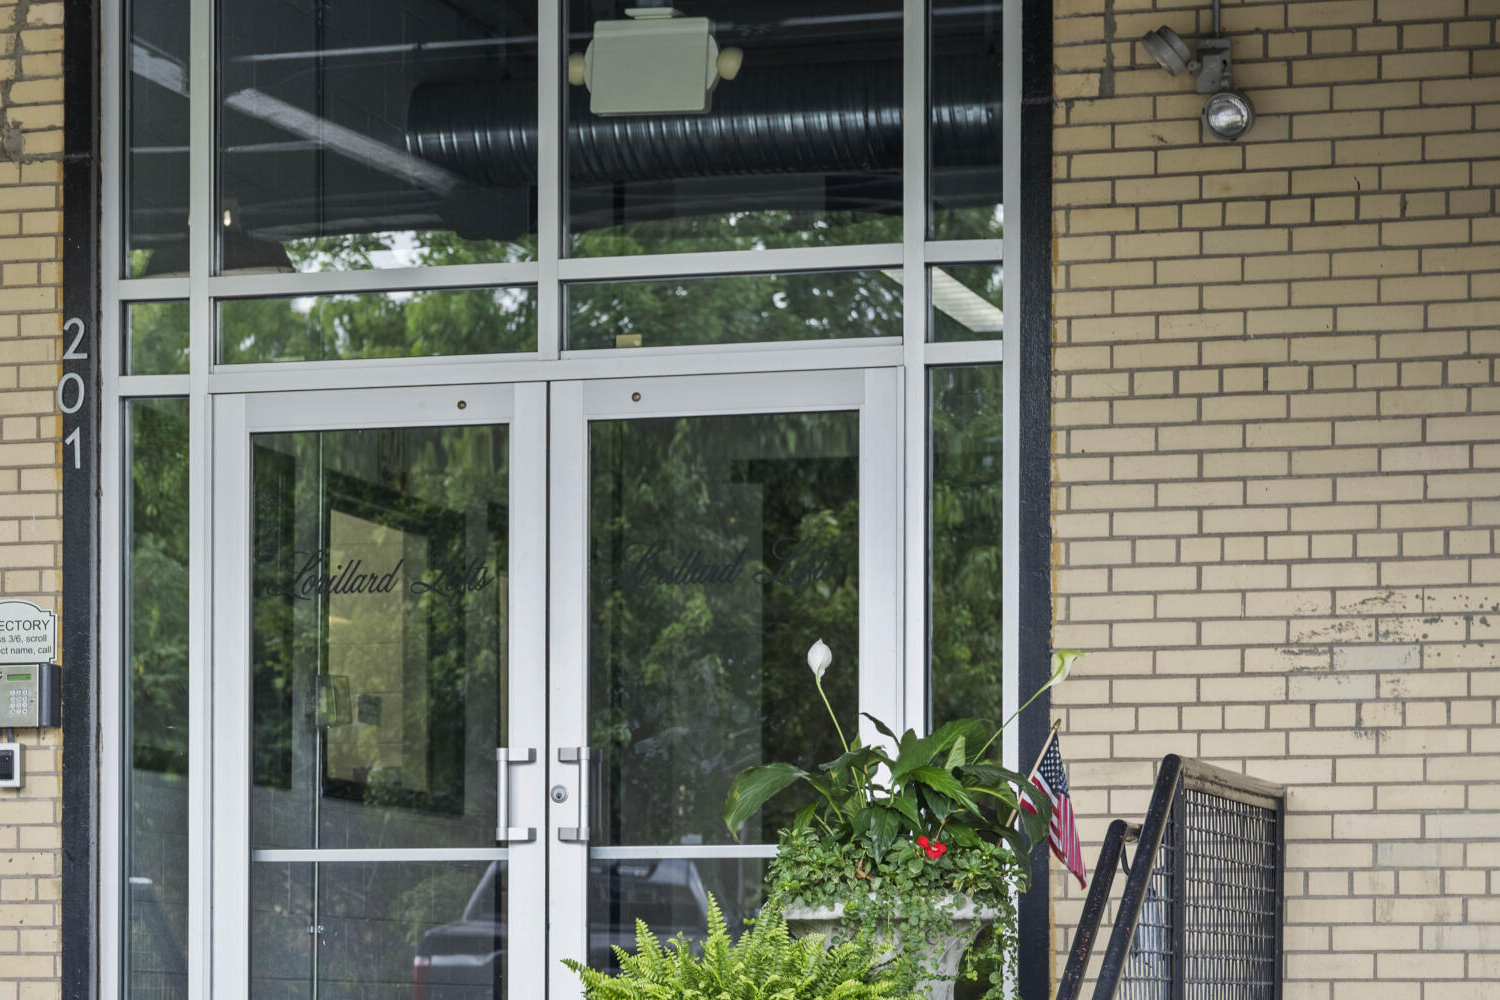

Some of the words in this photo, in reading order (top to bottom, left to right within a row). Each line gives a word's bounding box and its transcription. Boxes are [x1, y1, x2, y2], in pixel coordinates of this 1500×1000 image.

[57, 317, 88, 469] 201
[8, 634, 24, 644] 3/6,
[26, 634, 47, 643] scroll
[10, 647, 36, 655] name,
[38, 645, 52, 654] call
